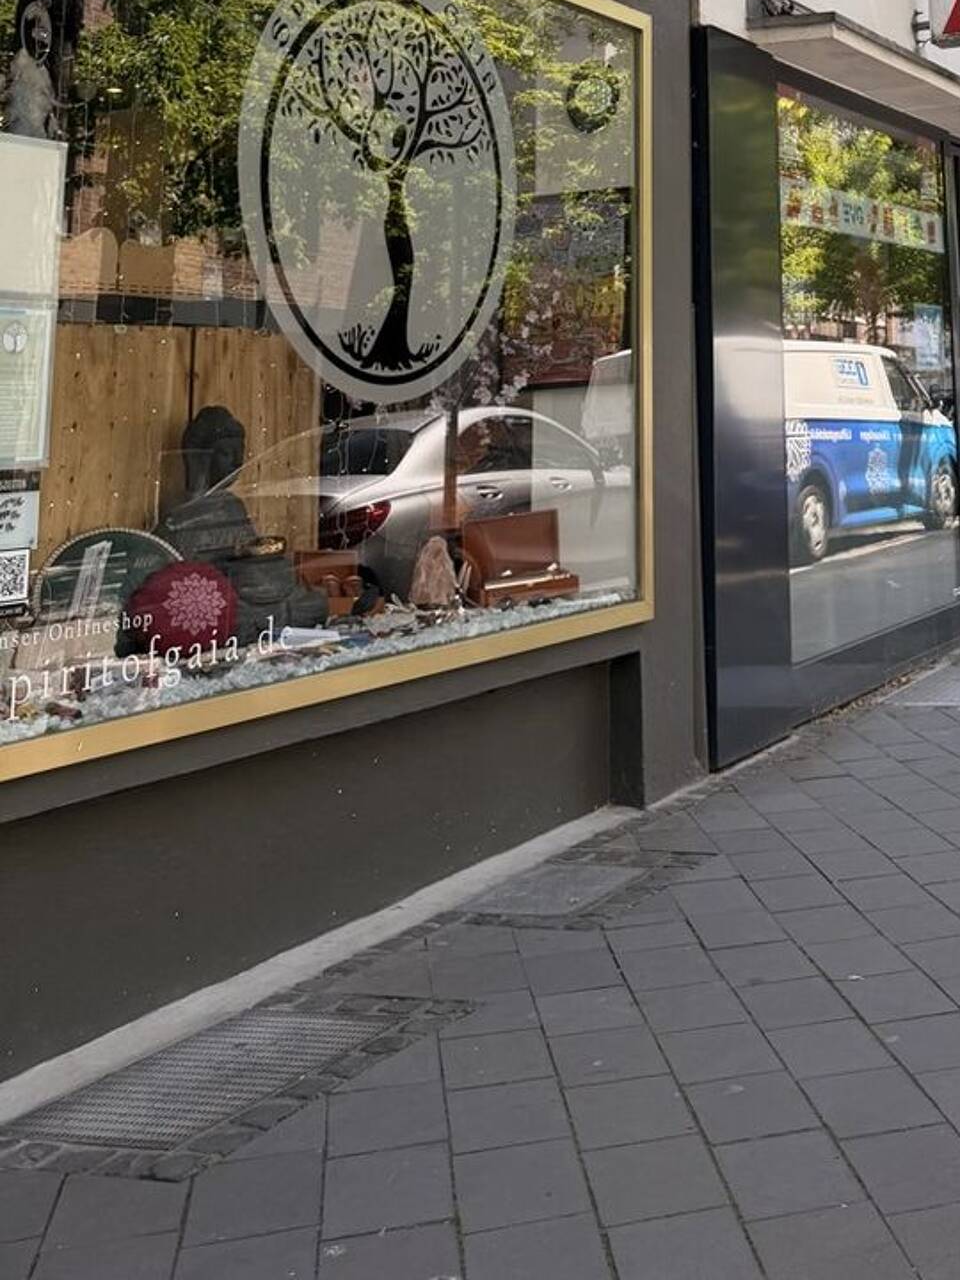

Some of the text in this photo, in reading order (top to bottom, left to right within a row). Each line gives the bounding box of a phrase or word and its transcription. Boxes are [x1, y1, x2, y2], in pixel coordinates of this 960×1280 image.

[0, 612, 153, 651] nser Onlineshop
[7, 616, 292, 721] piritofgaia.de
